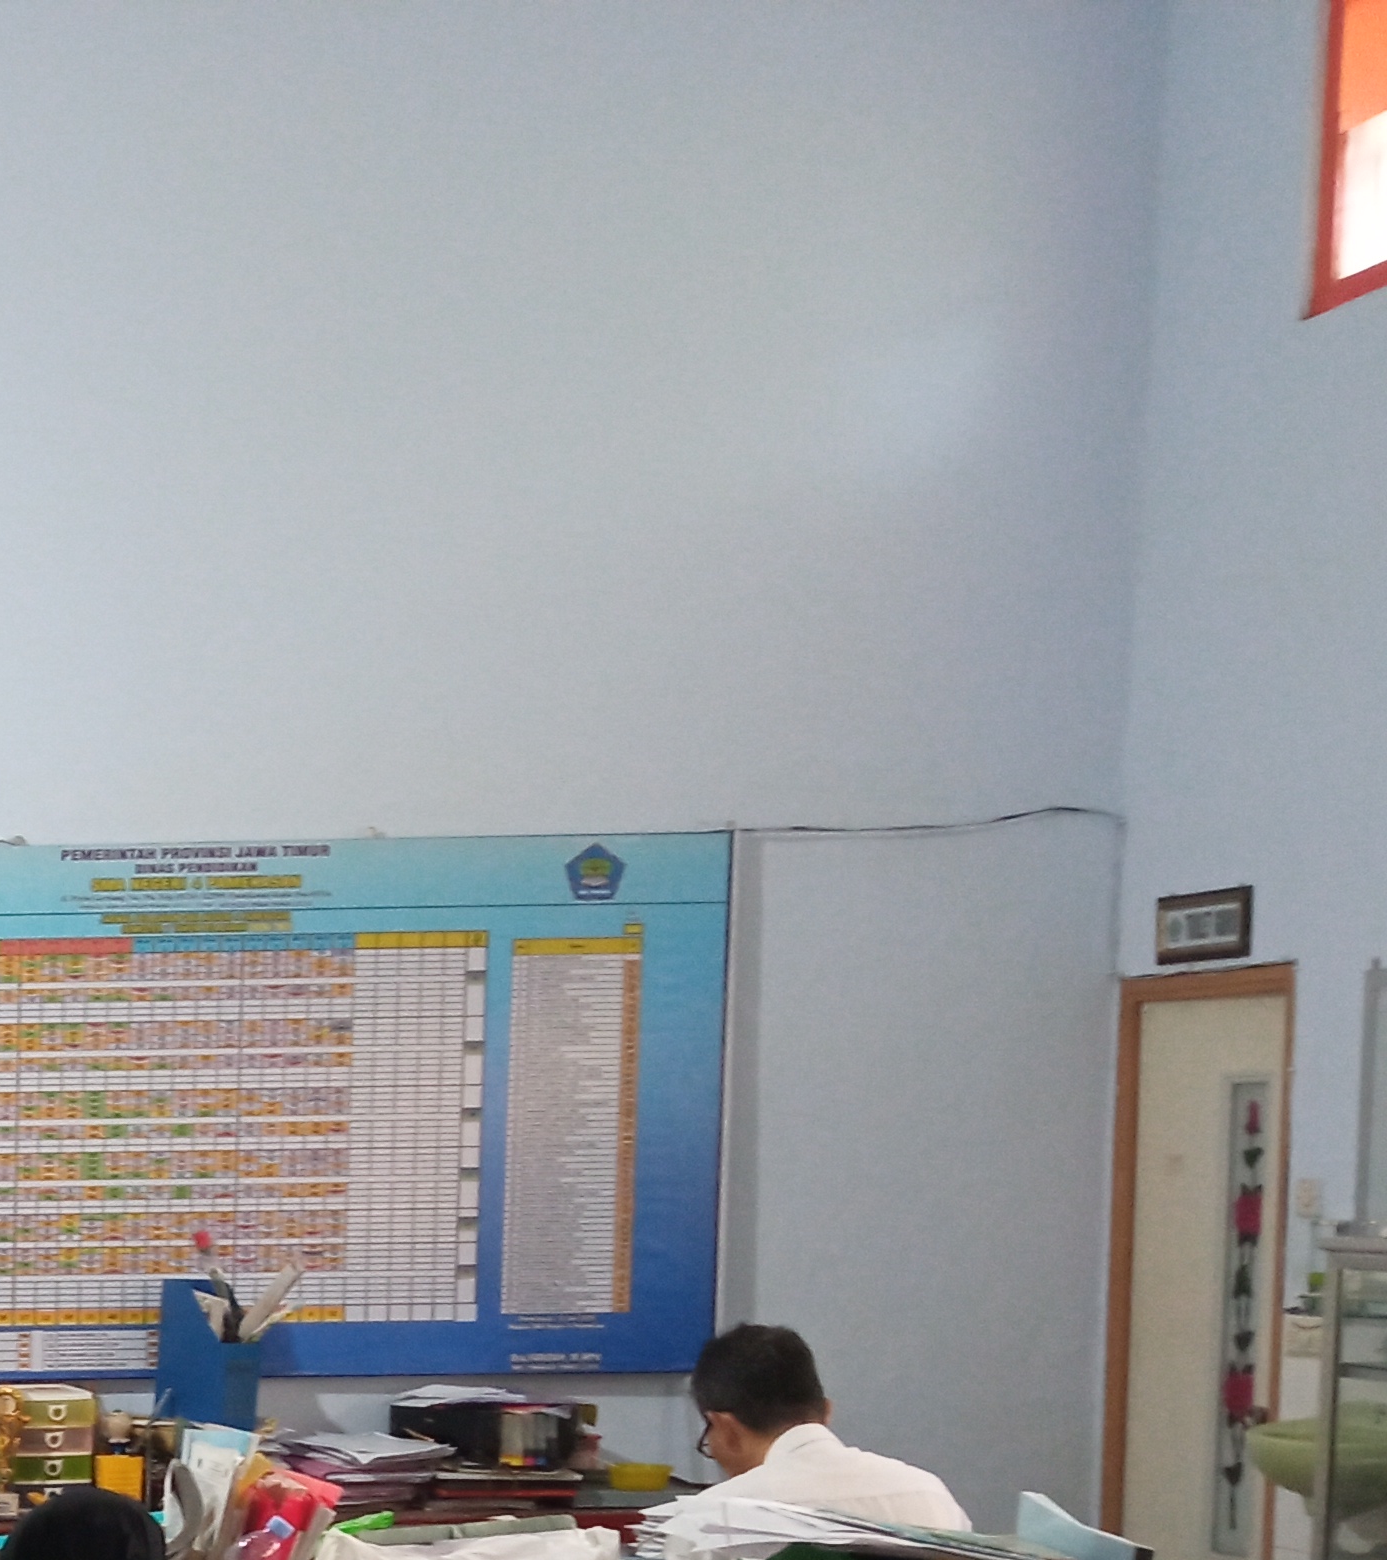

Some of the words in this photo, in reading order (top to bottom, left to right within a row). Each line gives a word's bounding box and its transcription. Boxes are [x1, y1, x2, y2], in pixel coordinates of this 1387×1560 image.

[60, 848, 157, 861] PEMERINTAH
[161, 847, 232, 860] PROVINSI
[235, 845, 277, 858] JAWA
[281, 844, 331, 857] TIMUR
[134, 863, 174, 875] DINAS
[177, 861, 258, 874] PENDIDIKAN
[91, 878, 125, 892] SMA
[130, 876, 187, 891] NEGERI
[206, 874, 302, 891] PAMEKASAN
